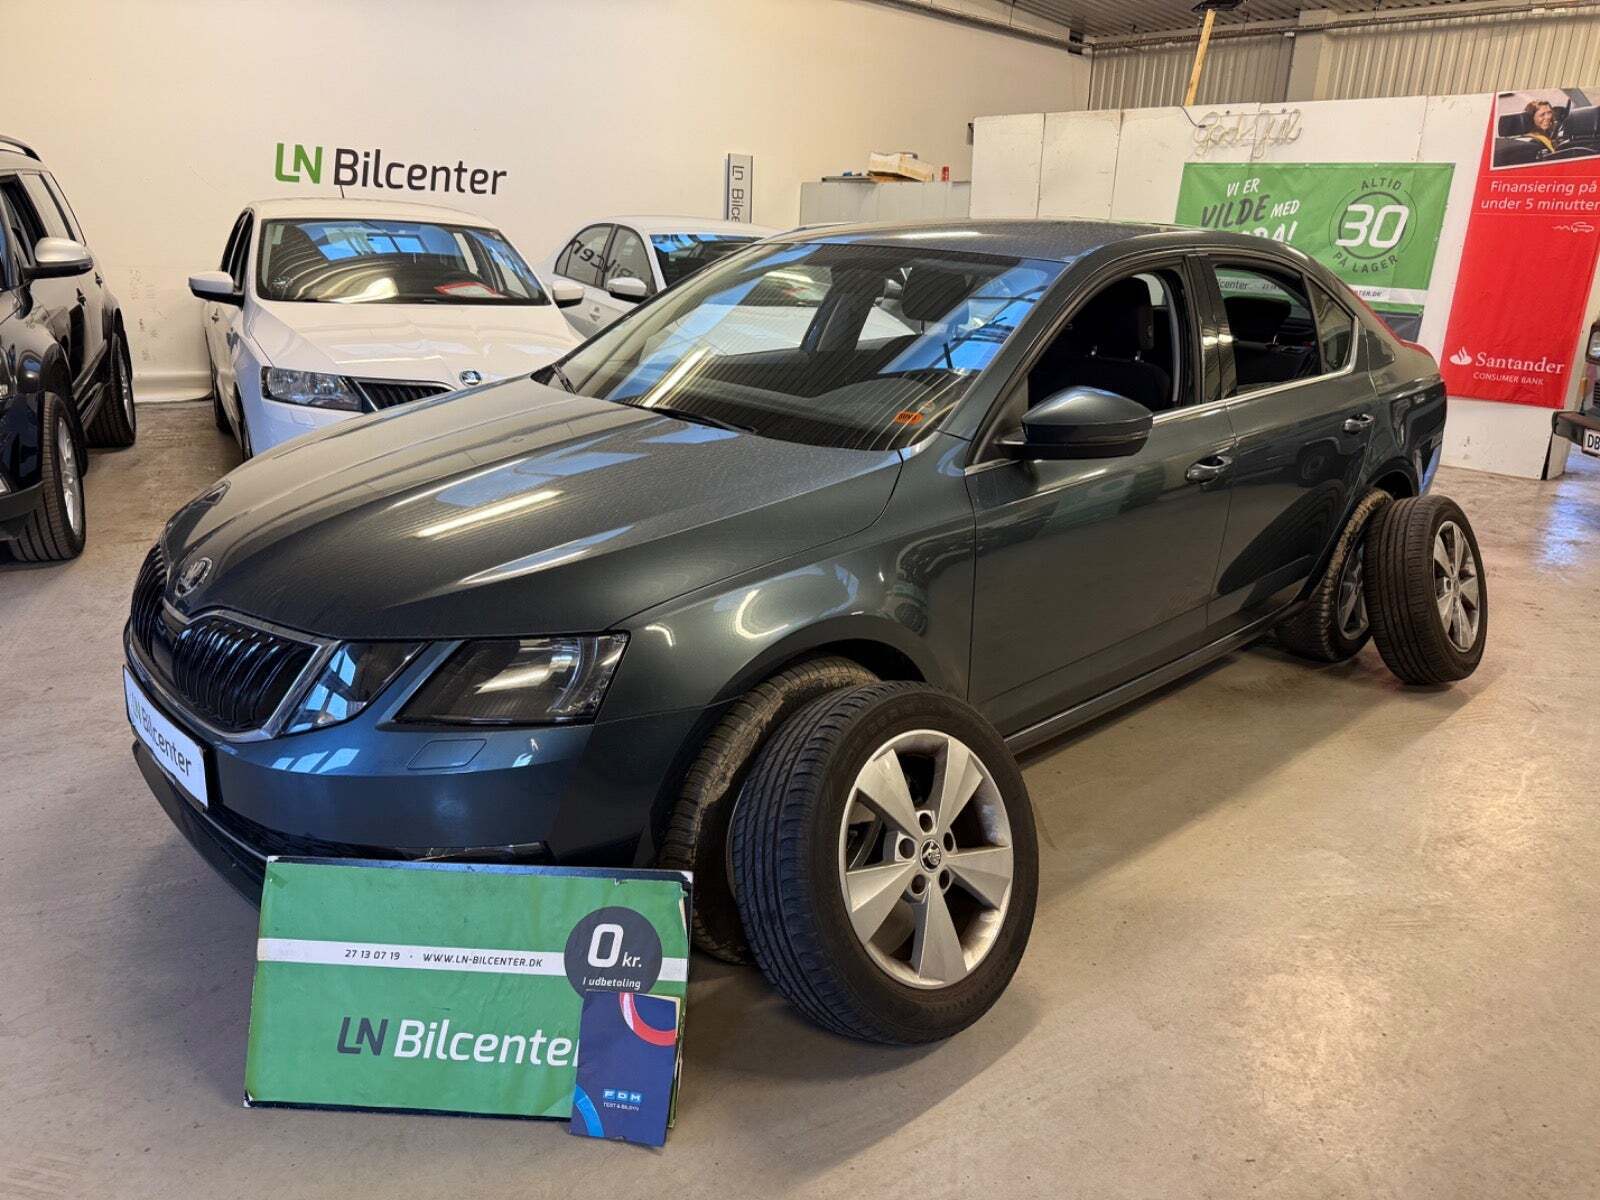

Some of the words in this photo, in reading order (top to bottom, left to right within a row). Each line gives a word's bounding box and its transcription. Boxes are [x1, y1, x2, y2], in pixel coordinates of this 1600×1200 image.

[275, 143, 323, 184] LN
[333, 148, 507, 195] Bilcenter
[1227, 182, 1239, 197] VI
[1243, 178, 1260, 193] ER
[1361, 178, 1402, 190] ALTID
[1490, 181, 1575, 196] Finansiering
[1578, 180, 1597, 195] på
[1201, 194, 1270, 228] VILDE
[1270, 200, 1300, 218] MED
[1481, 197, 1521, 209] under
[1525, 198, 1534, 209] 5
[1335, 204, 1410, 248] 30
[1333, 252, 1348, 268] PÅ
[1352, 255, 1399, 273] LAGER
[1475, 352, 1565, 374] Santander
[1473, 371, 1519, 383] CONSUMER
[1521, 376, 1544, 385] BANK
[141, 707, 192, 777] Bilcenter
[588, 924, 624, 967] 0
[622, 952, 642, 967] kr.
[345, 949, 357, 958] 27
[361, 950, 370, 959] 13
[373, 951, 387, 960] 07
[390, 951, 400, 960] 19
[423, 953, 543, 967] WWW.LN-BILCENTER.DK
[588, 977, 641, 990] udbetaling
[337, 1017, 389, 1056] LN
[604, 1090, 641, 1101] FDM
